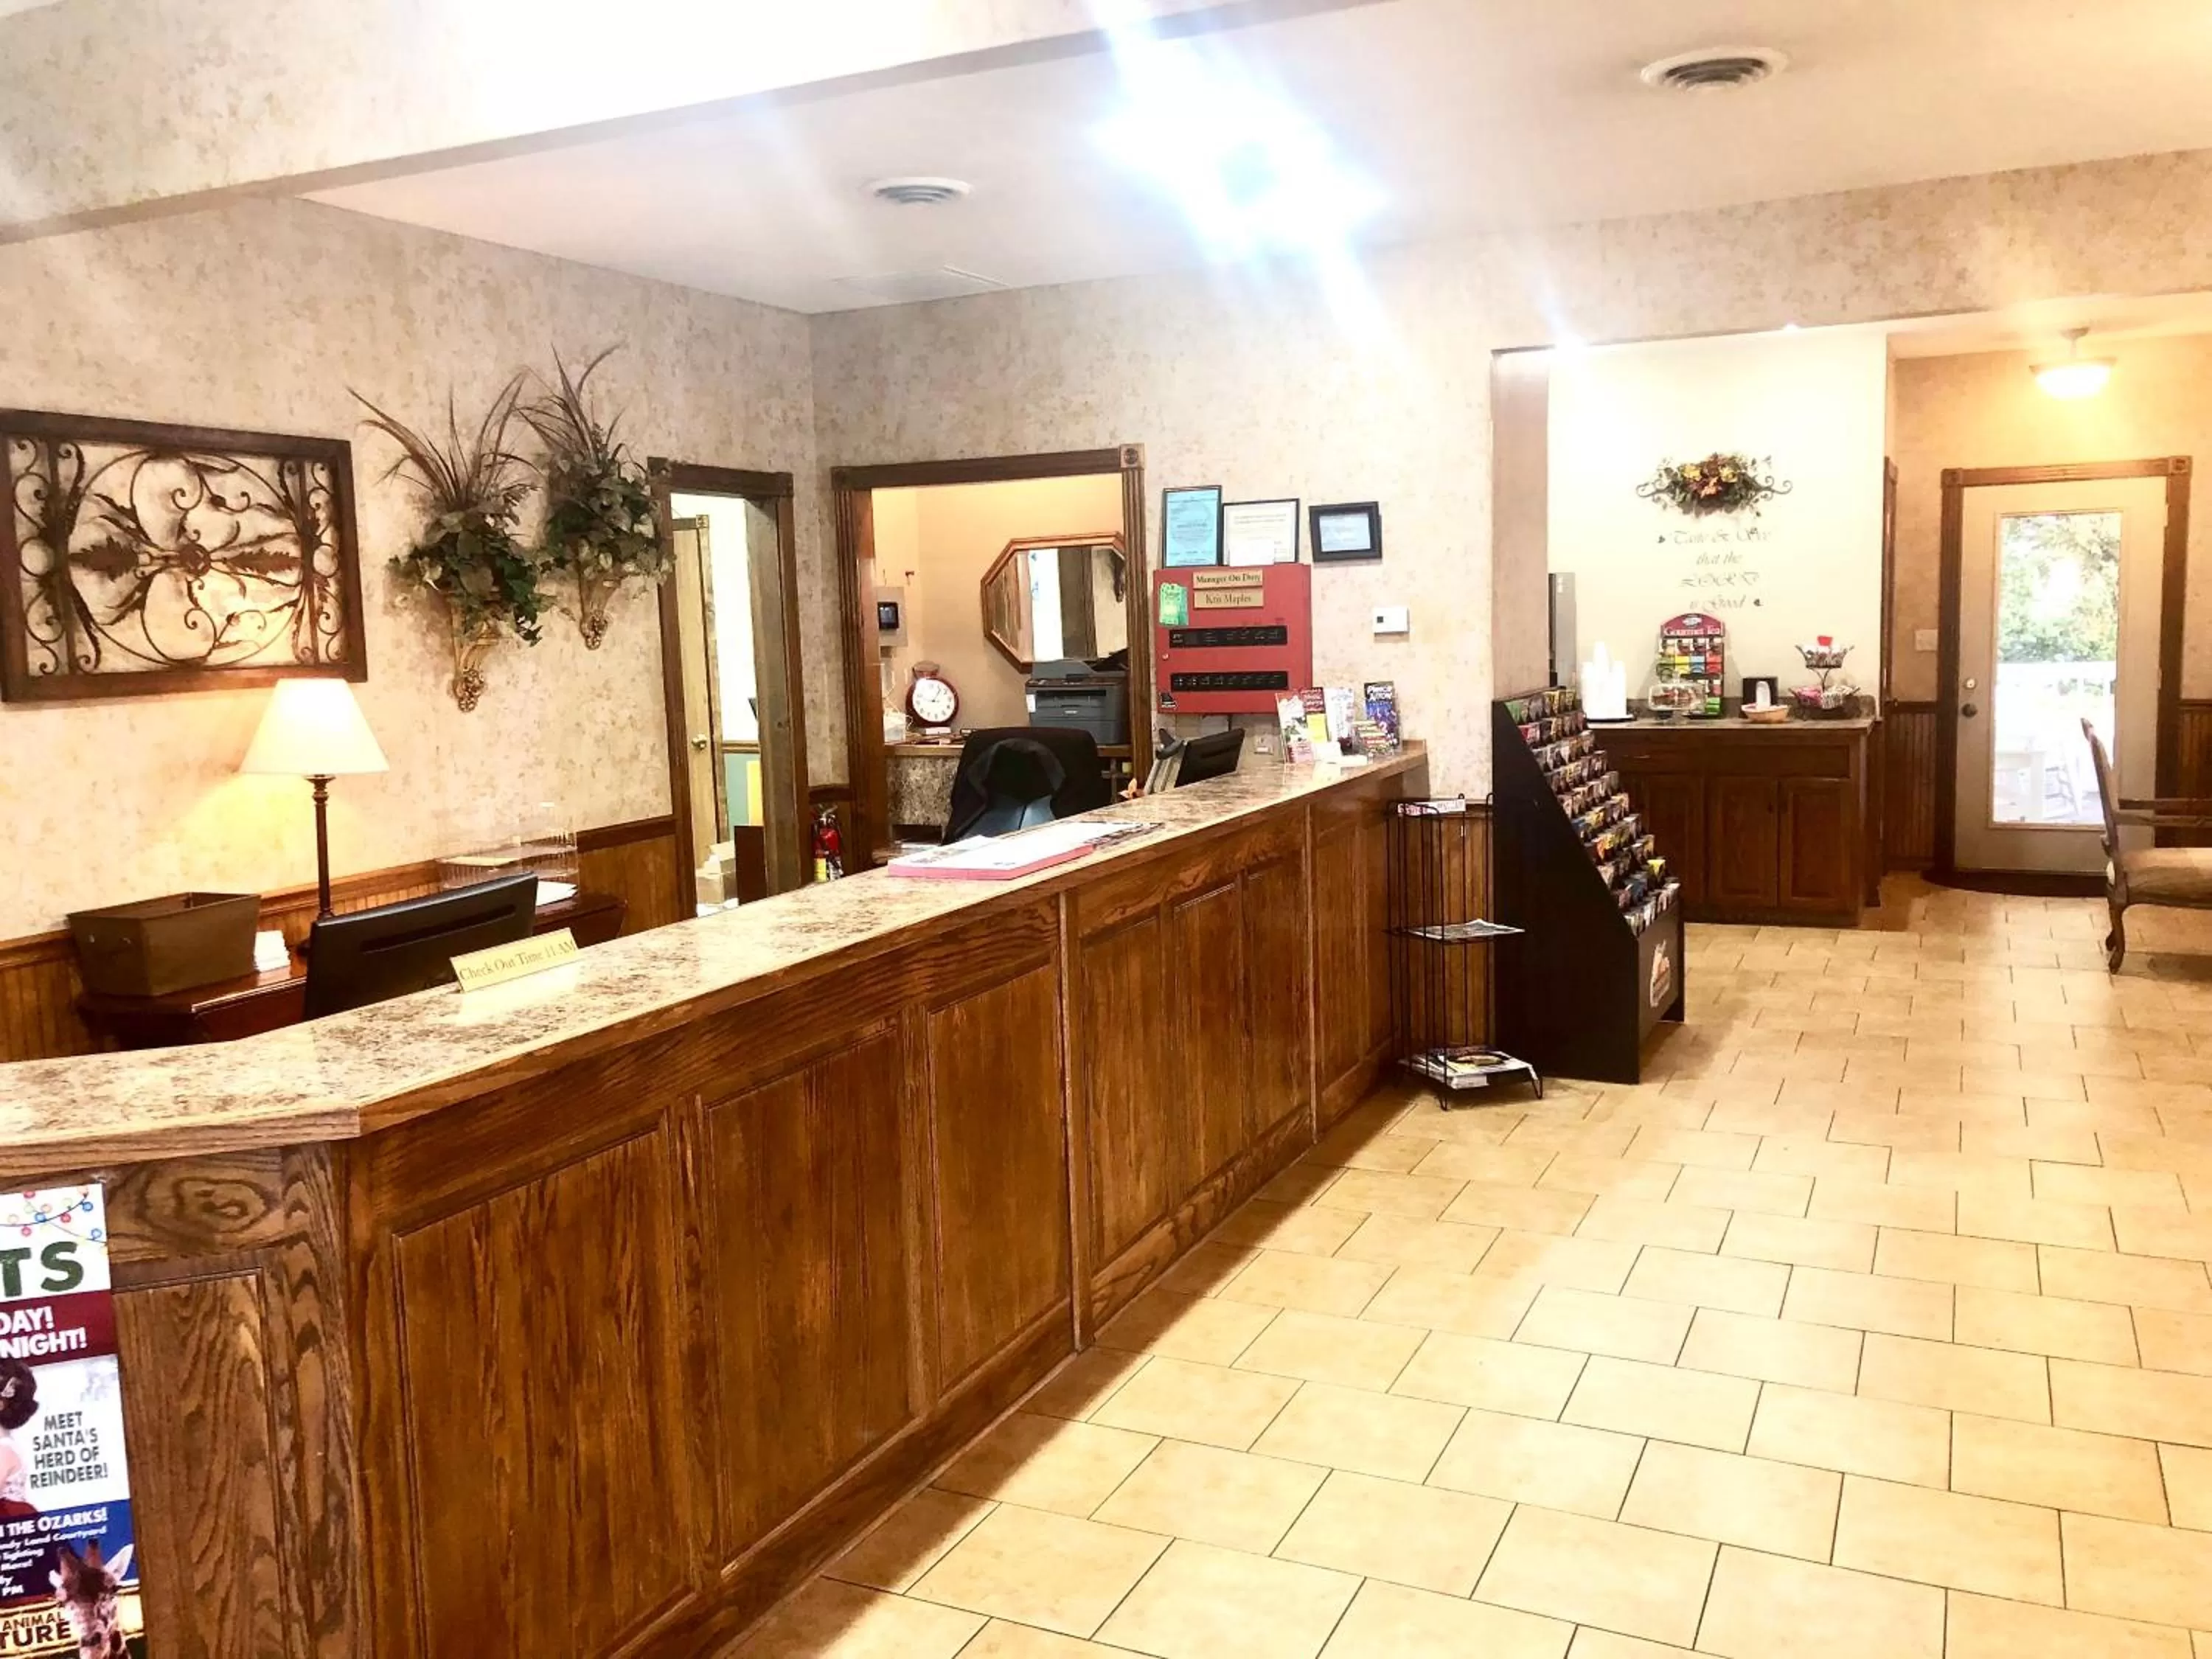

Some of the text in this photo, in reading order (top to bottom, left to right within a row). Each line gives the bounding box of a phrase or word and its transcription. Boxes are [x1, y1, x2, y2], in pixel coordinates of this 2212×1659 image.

[459, 961, 493, 981] Check
[493, 958, 516, 971] Out
[515, 951, 543, 966] Time
[0, 1327, 87, 1359] NIGHT!
[44, 1411, 83, 1431] MEET
[32, 1427, 98, 1452] SANTA'S
[35, 1446, 100, 1470] HERD OF
[29, 1463, 108, 1489] REINDEER!
[7, 1520, 36, 1537] THE
[2, 1585, 24, 1596] PM
[3, 1610, 66, 1632] ANIMAL
[0, 1621, 72, 1649] TURE
